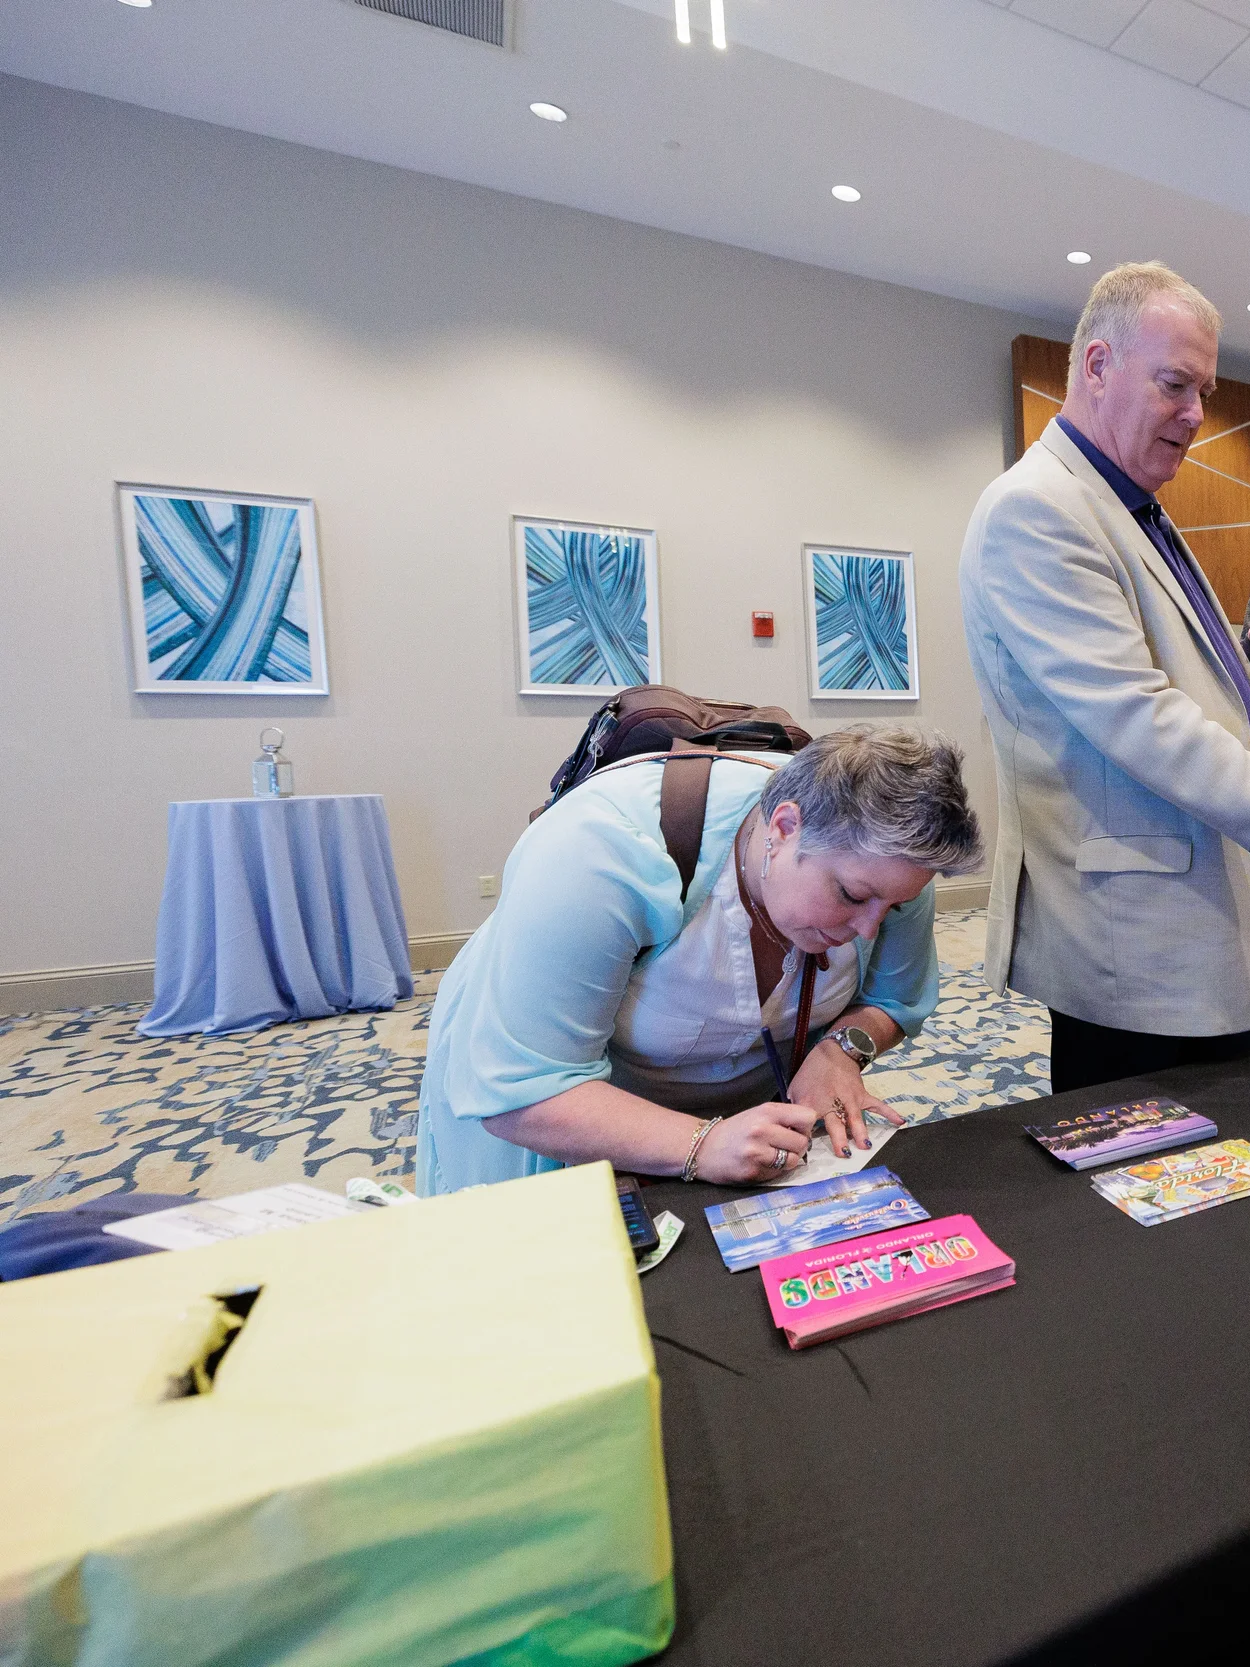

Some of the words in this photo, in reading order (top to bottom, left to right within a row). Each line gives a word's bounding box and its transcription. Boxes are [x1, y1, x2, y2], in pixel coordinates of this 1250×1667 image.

[1057, 1101, 1159, 1127] ORLANDO
[1155, 1157, 1239, 1189] Florida
[876, 1231, 934, 1249] ORLANDO
[805, 1249, 859, 1268] FLORIDA
[780, 1235, 978, 1309] ORLANDO
